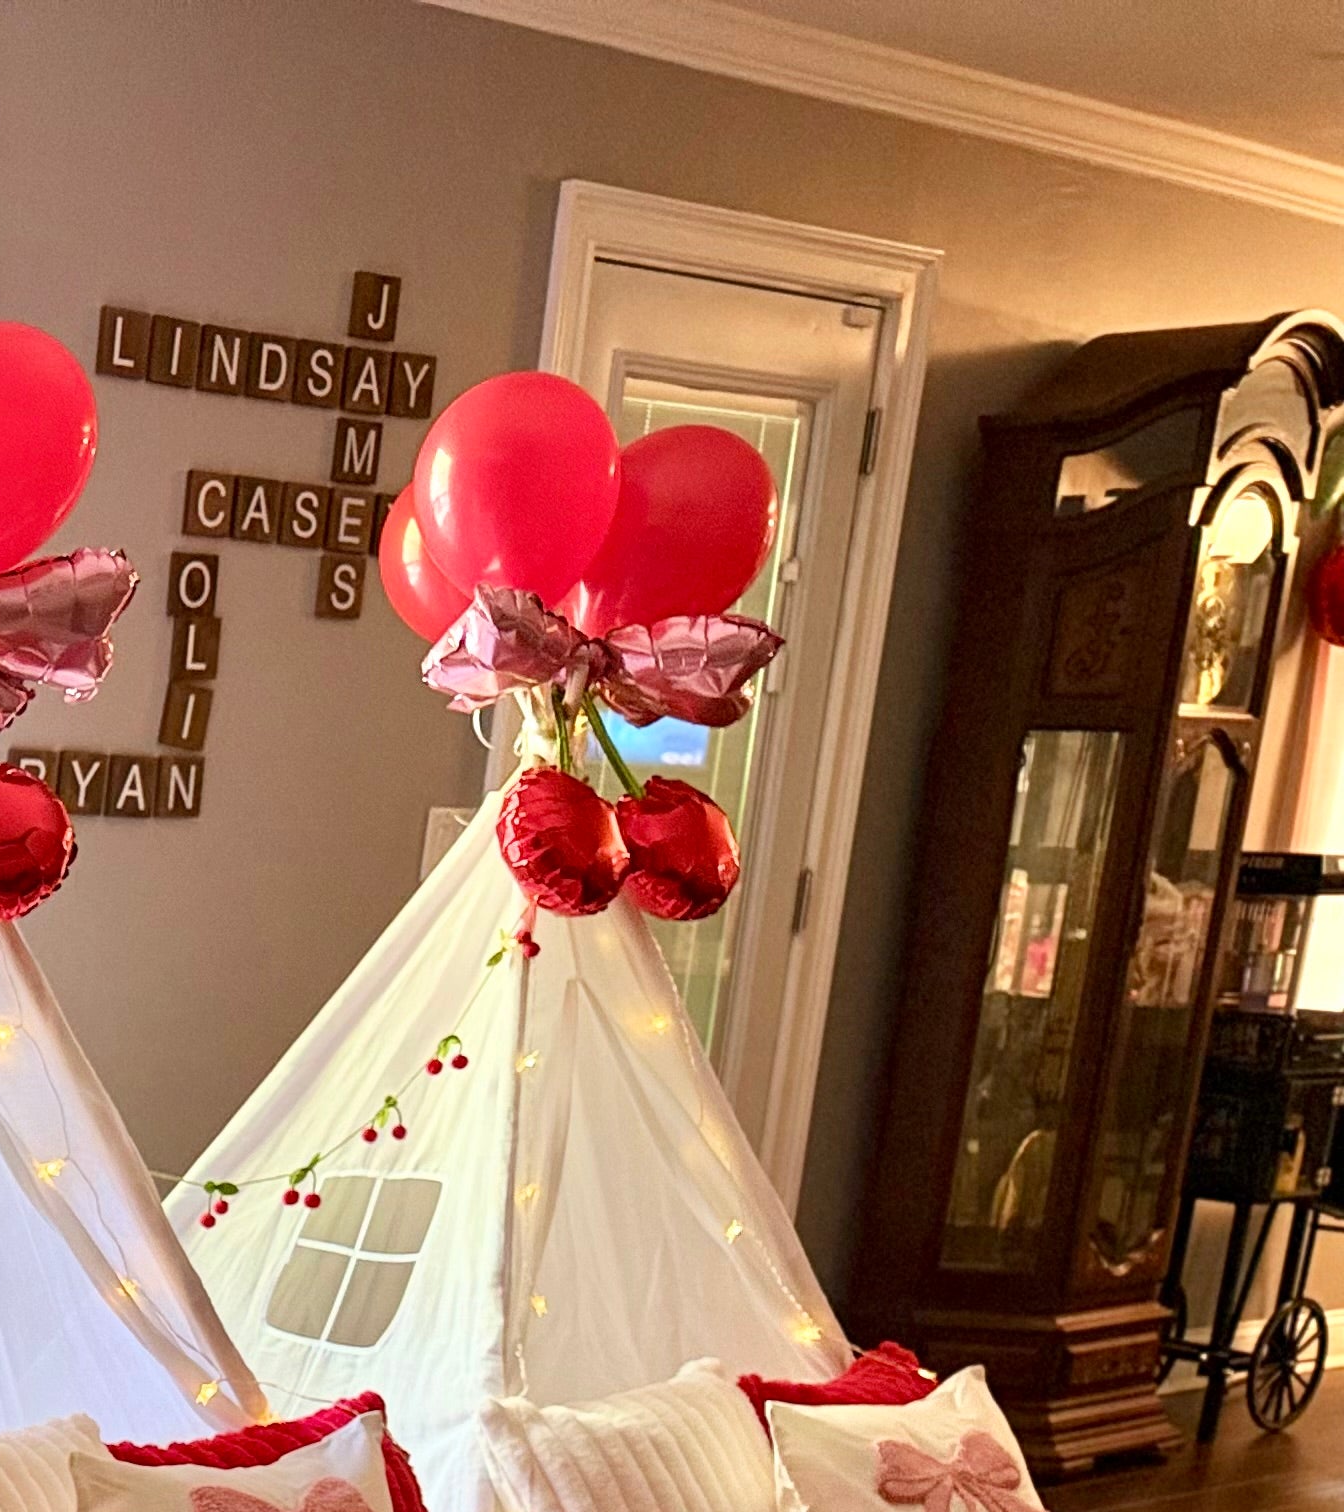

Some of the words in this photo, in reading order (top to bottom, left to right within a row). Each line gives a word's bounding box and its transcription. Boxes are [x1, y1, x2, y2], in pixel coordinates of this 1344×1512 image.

[112, 314, 430, 408] LINDSAY
[330, 283, 391, 611] JAMES
[196, 479, 395, 546] CASE
